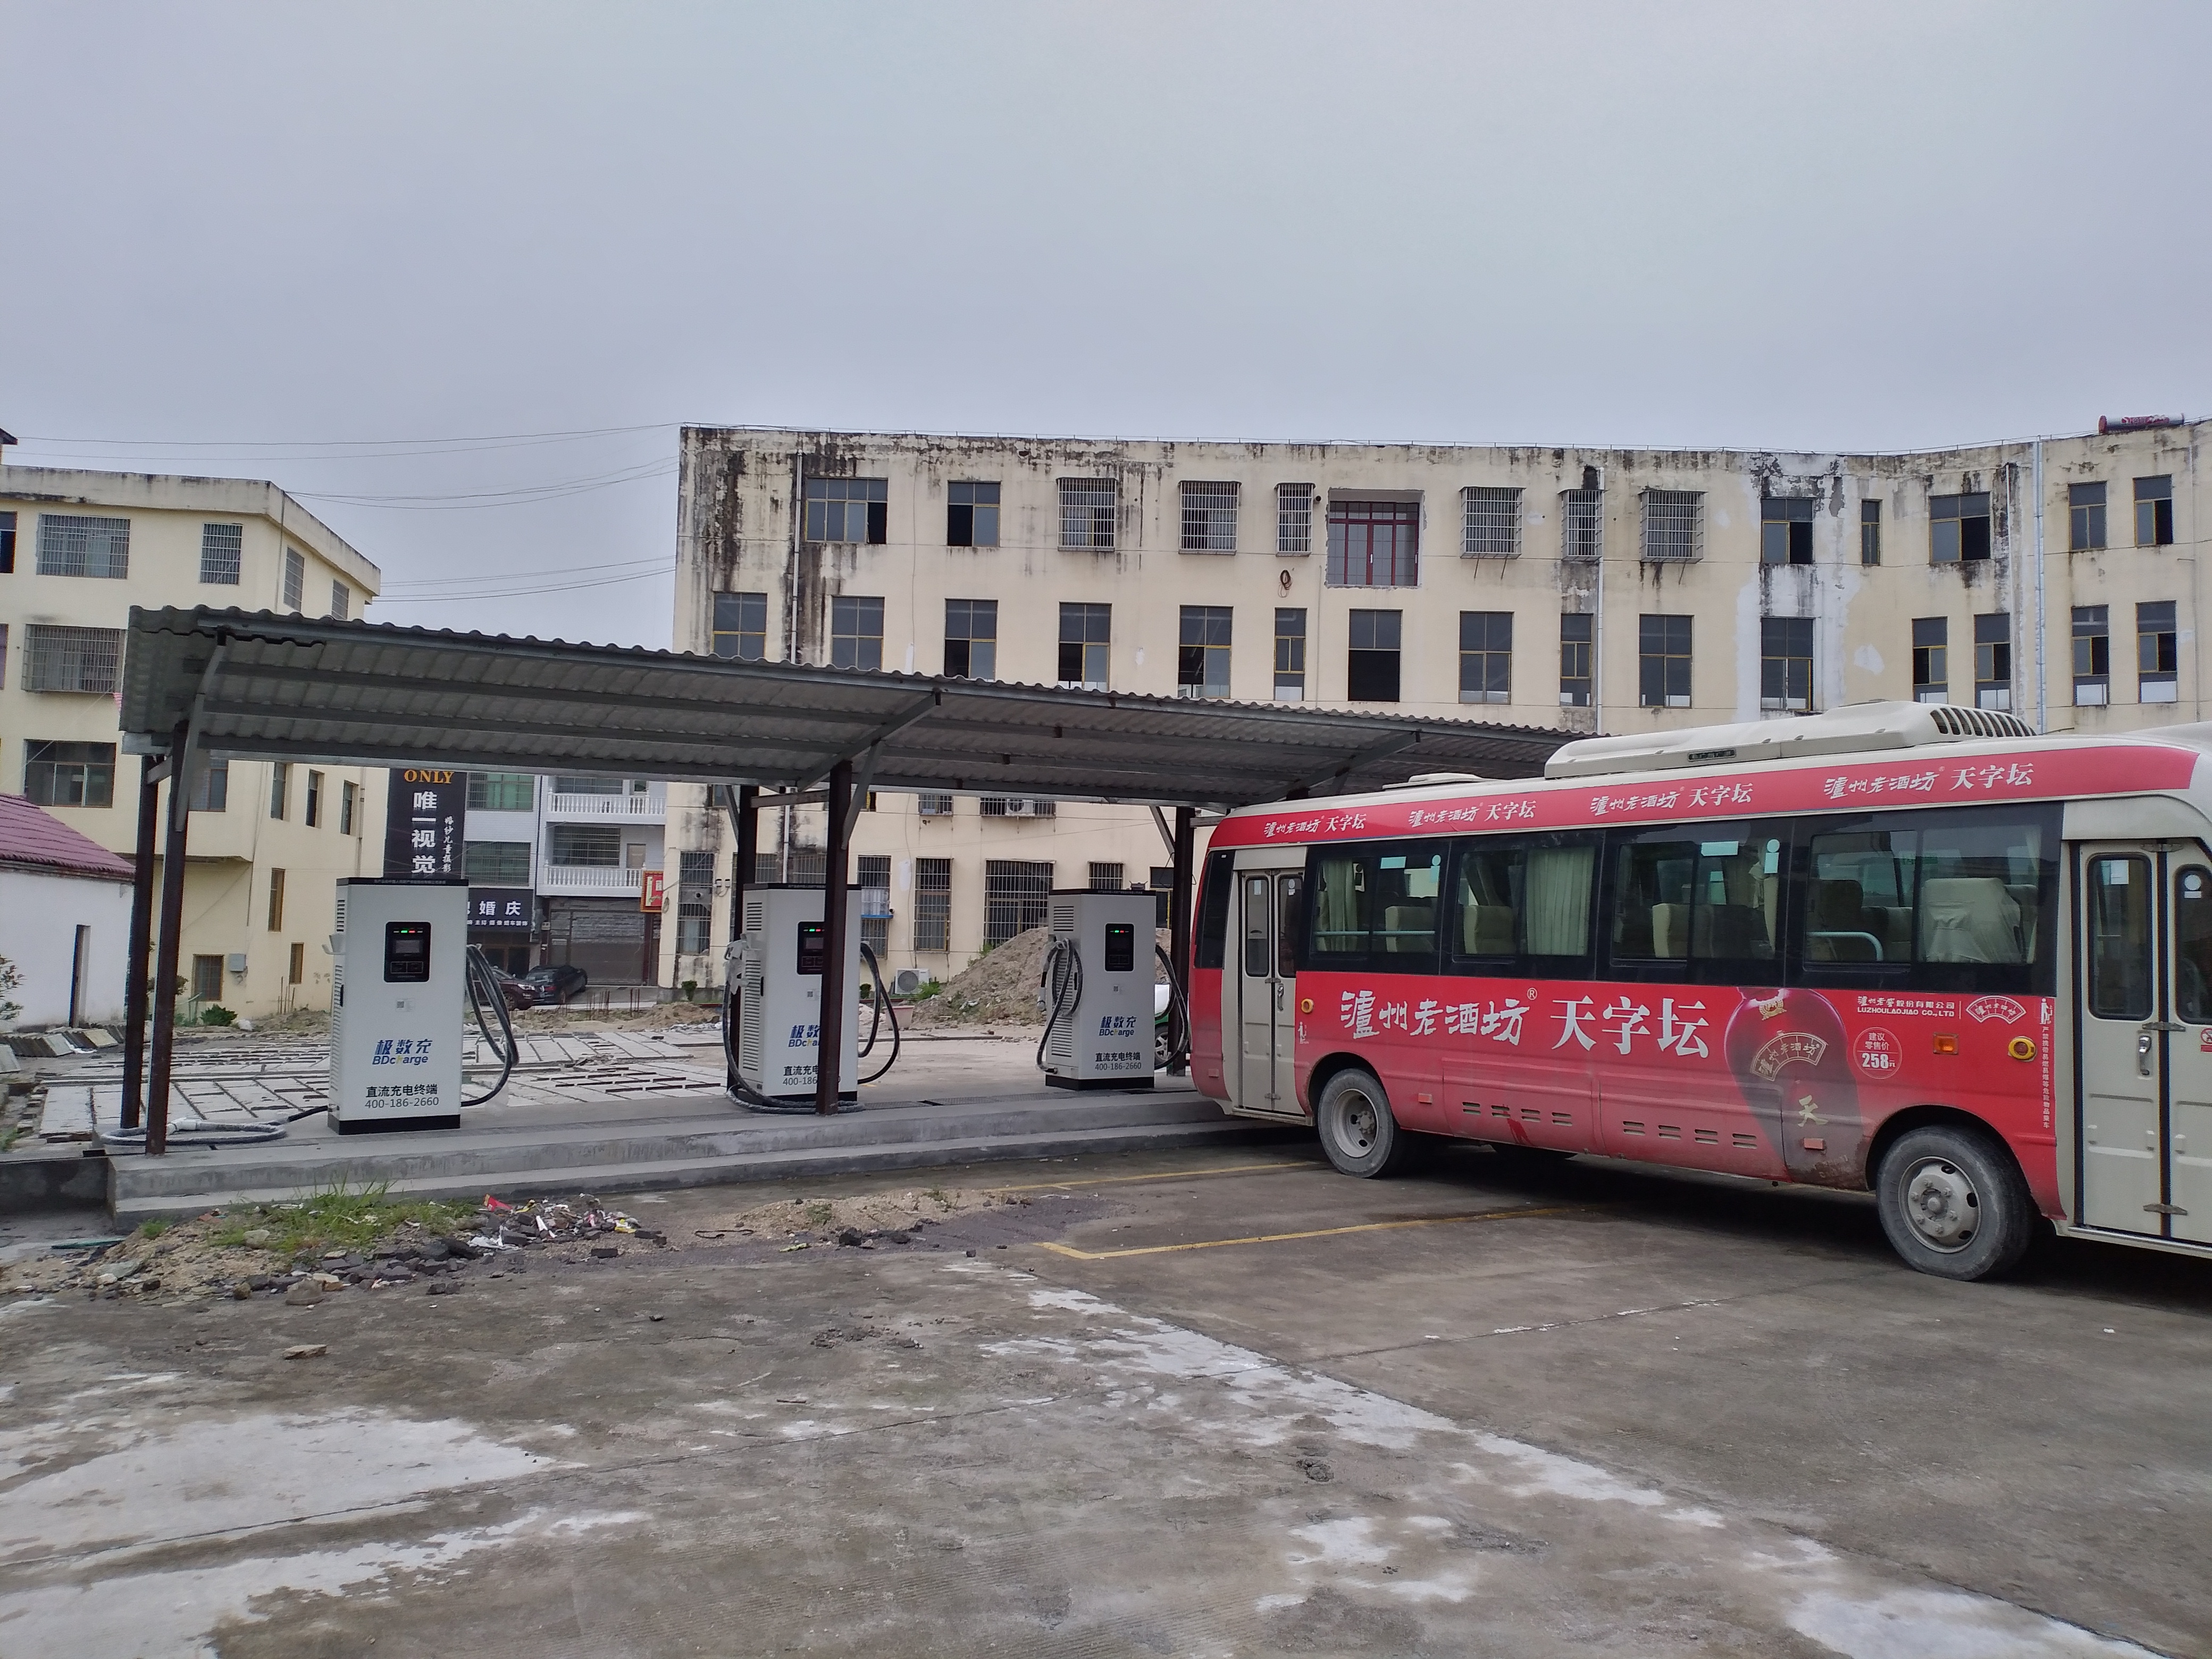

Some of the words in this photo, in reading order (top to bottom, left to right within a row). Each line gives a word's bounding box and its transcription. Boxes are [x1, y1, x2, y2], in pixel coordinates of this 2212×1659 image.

[404, 769, 455, 784] ONLY
[1949, 763, 2033, 791] 天字坛
[1687, 783, 1754, 808] 天字坛
[1484, 800, 1537, 822] 天字坛
[1325, 813, 1367, 833] 天字坛
[411, 791, 438, 874] 唯一视觉
[1857, 1007, 1919, 1016] LUZHOULAOJIAO
[1100, 1016, 1137, 1028] 极数充
[1549, 994, 1710, 1059] 天字坛
[790, 1024, 820, 1038] 极数
[1099, 1028, 1135, 1037] BDcharge
[1869, 1033, 1886, 1041] 建议
[374, 1038, 433, 1055] 极数充
[788, 1038, 819, 1048] BDcha
[1865, 1041, 1890, 1051] 零售价
[372, 1055, 429, 1066] BDcharge
[1095, 1051, 1141, 1062] 直流充电终端
[783, 1065, 818, 1076] 直流充电
[1094, 1062, 1142, 1070] 400-186-2660
[783, 1076, 818, 1086] 400-186
[366, 1083, 438, 1098] 直流充电终端
[365, 1096, 439, 1109] 400-186-2660
